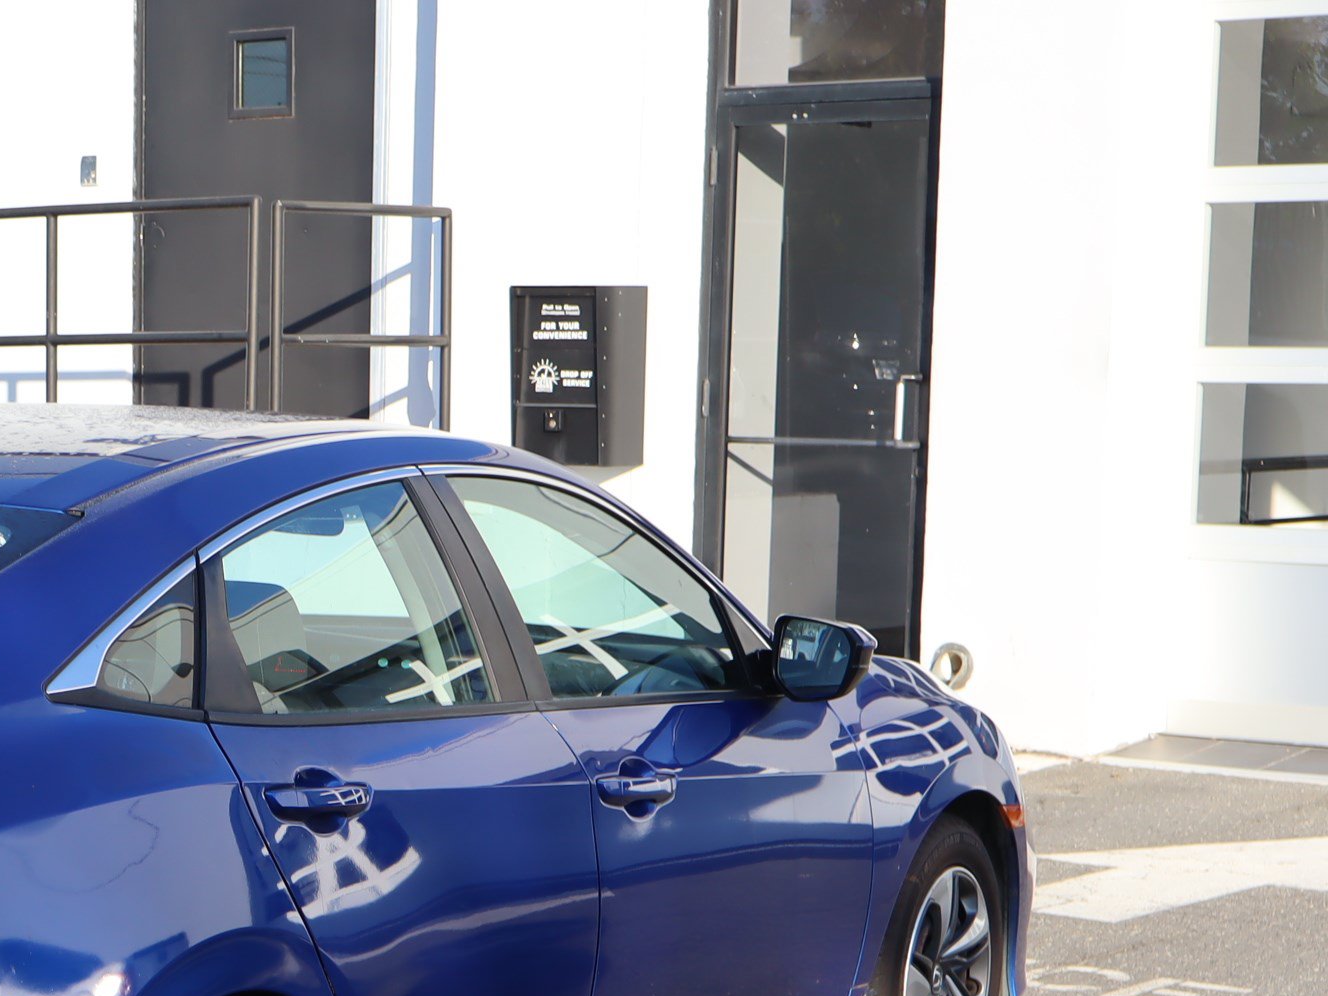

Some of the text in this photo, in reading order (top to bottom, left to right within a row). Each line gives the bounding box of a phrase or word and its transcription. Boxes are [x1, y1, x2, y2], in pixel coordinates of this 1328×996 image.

[541, 321, 580, 330] FOR YOUR
[533, 331, 588, 340] CONVENIENCE
[560, 370, 593, 378] DROP OFF
[562, 379, 590, 387] SERVICE
